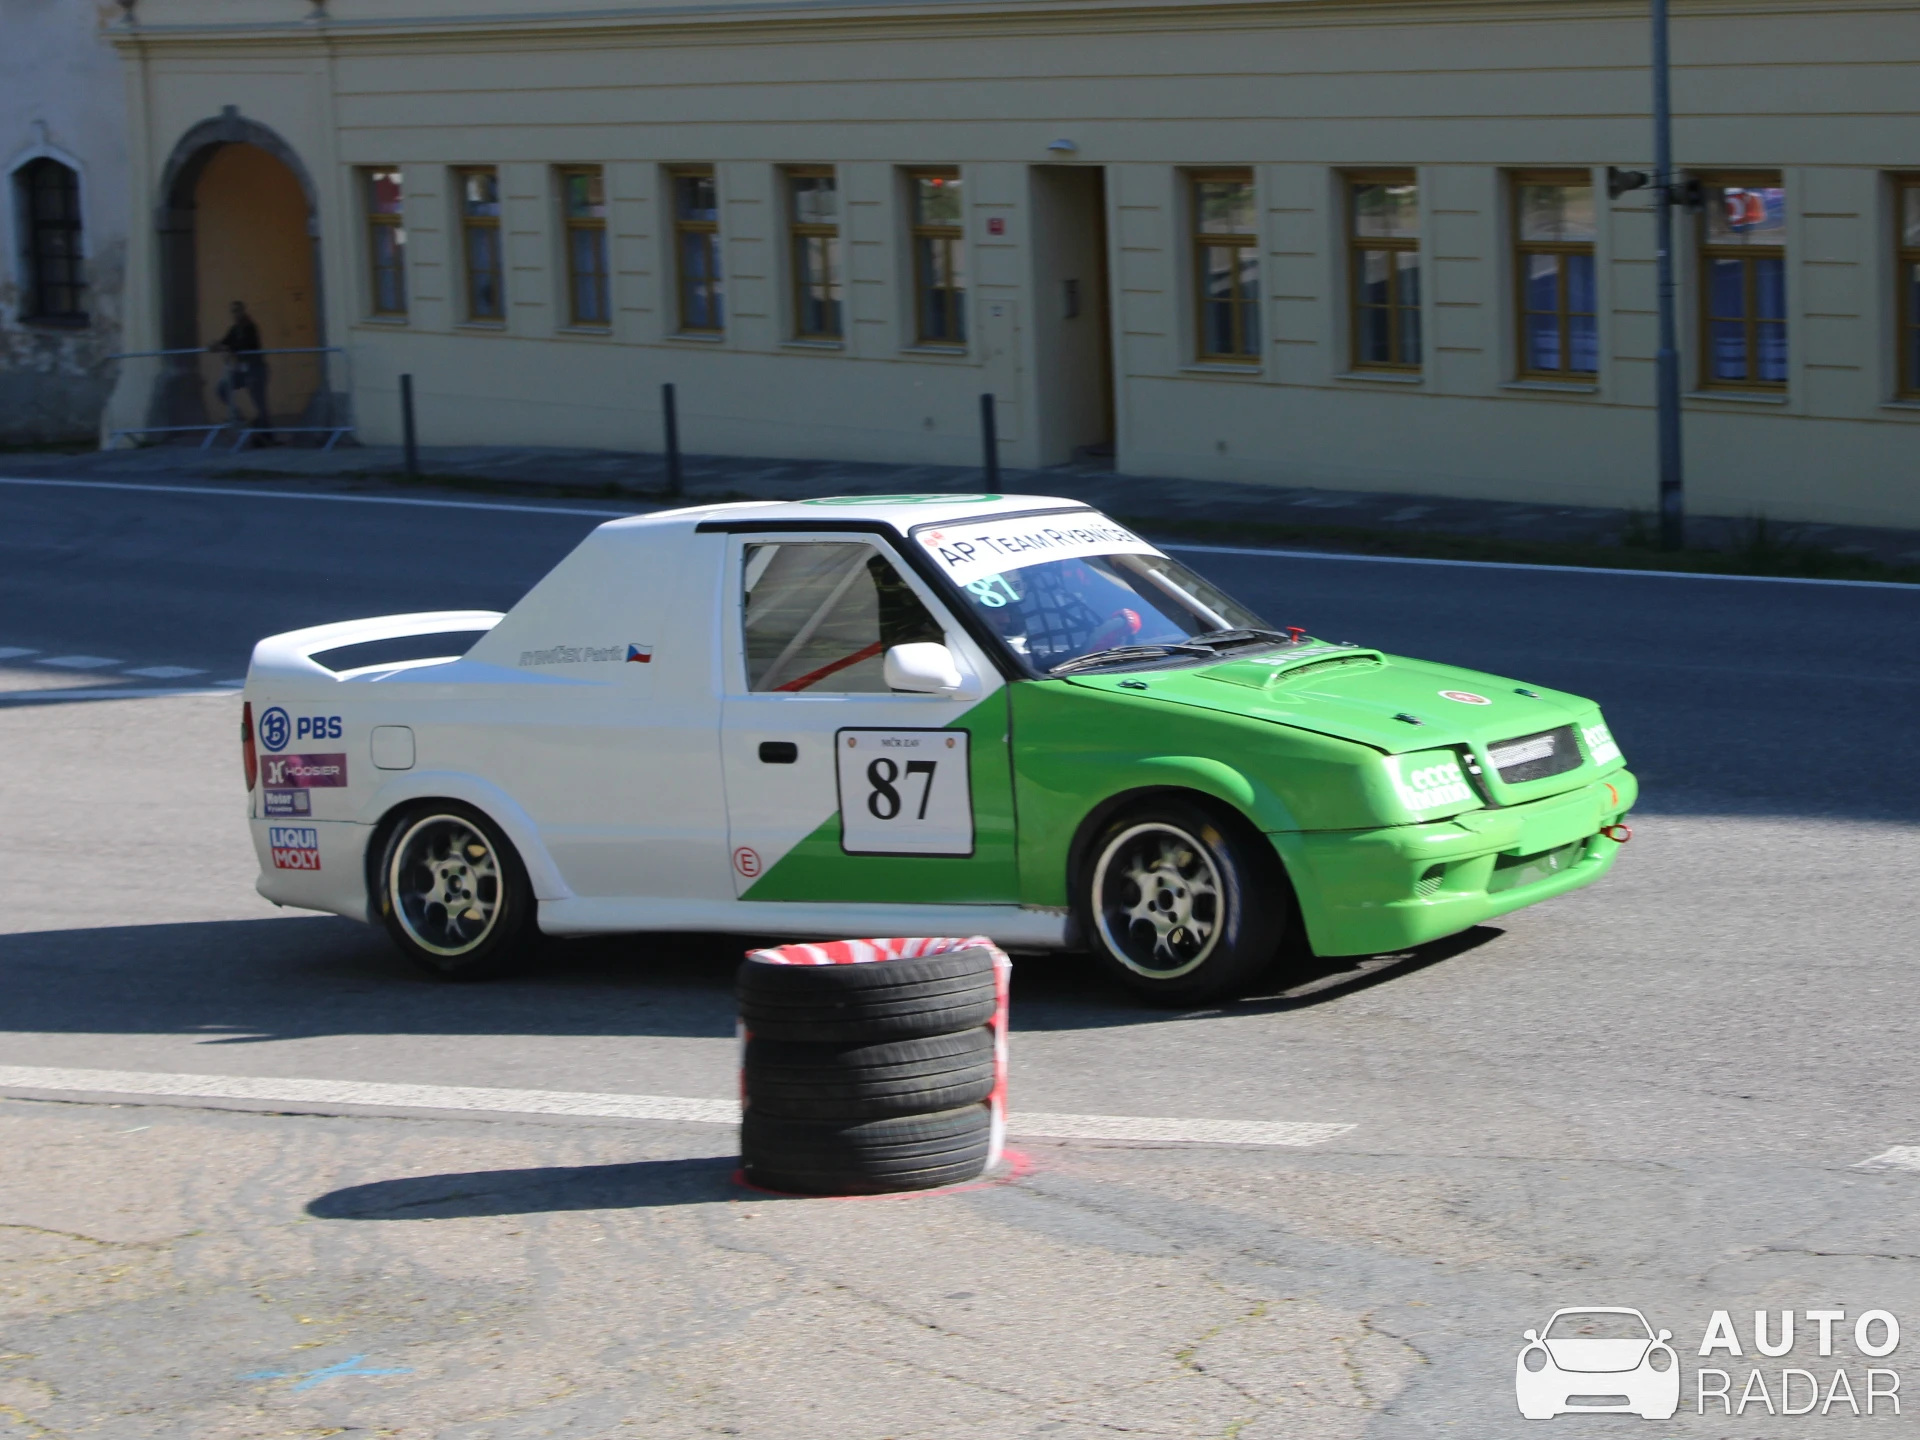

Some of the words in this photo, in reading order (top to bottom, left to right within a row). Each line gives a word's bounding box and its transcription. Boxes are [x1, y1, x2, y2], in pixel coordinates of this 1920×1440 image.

[938, 541, 977, 567] AP
[966, 572, 1020, 608] 87
[297, 716, 342, 740] PBS
[286, 766, 340, 776] HOOSIER
[867, 757, 938, 820] 87
[271, 829, 316, 848] LIQUI
[274, 849, 318, 868] MOLY
